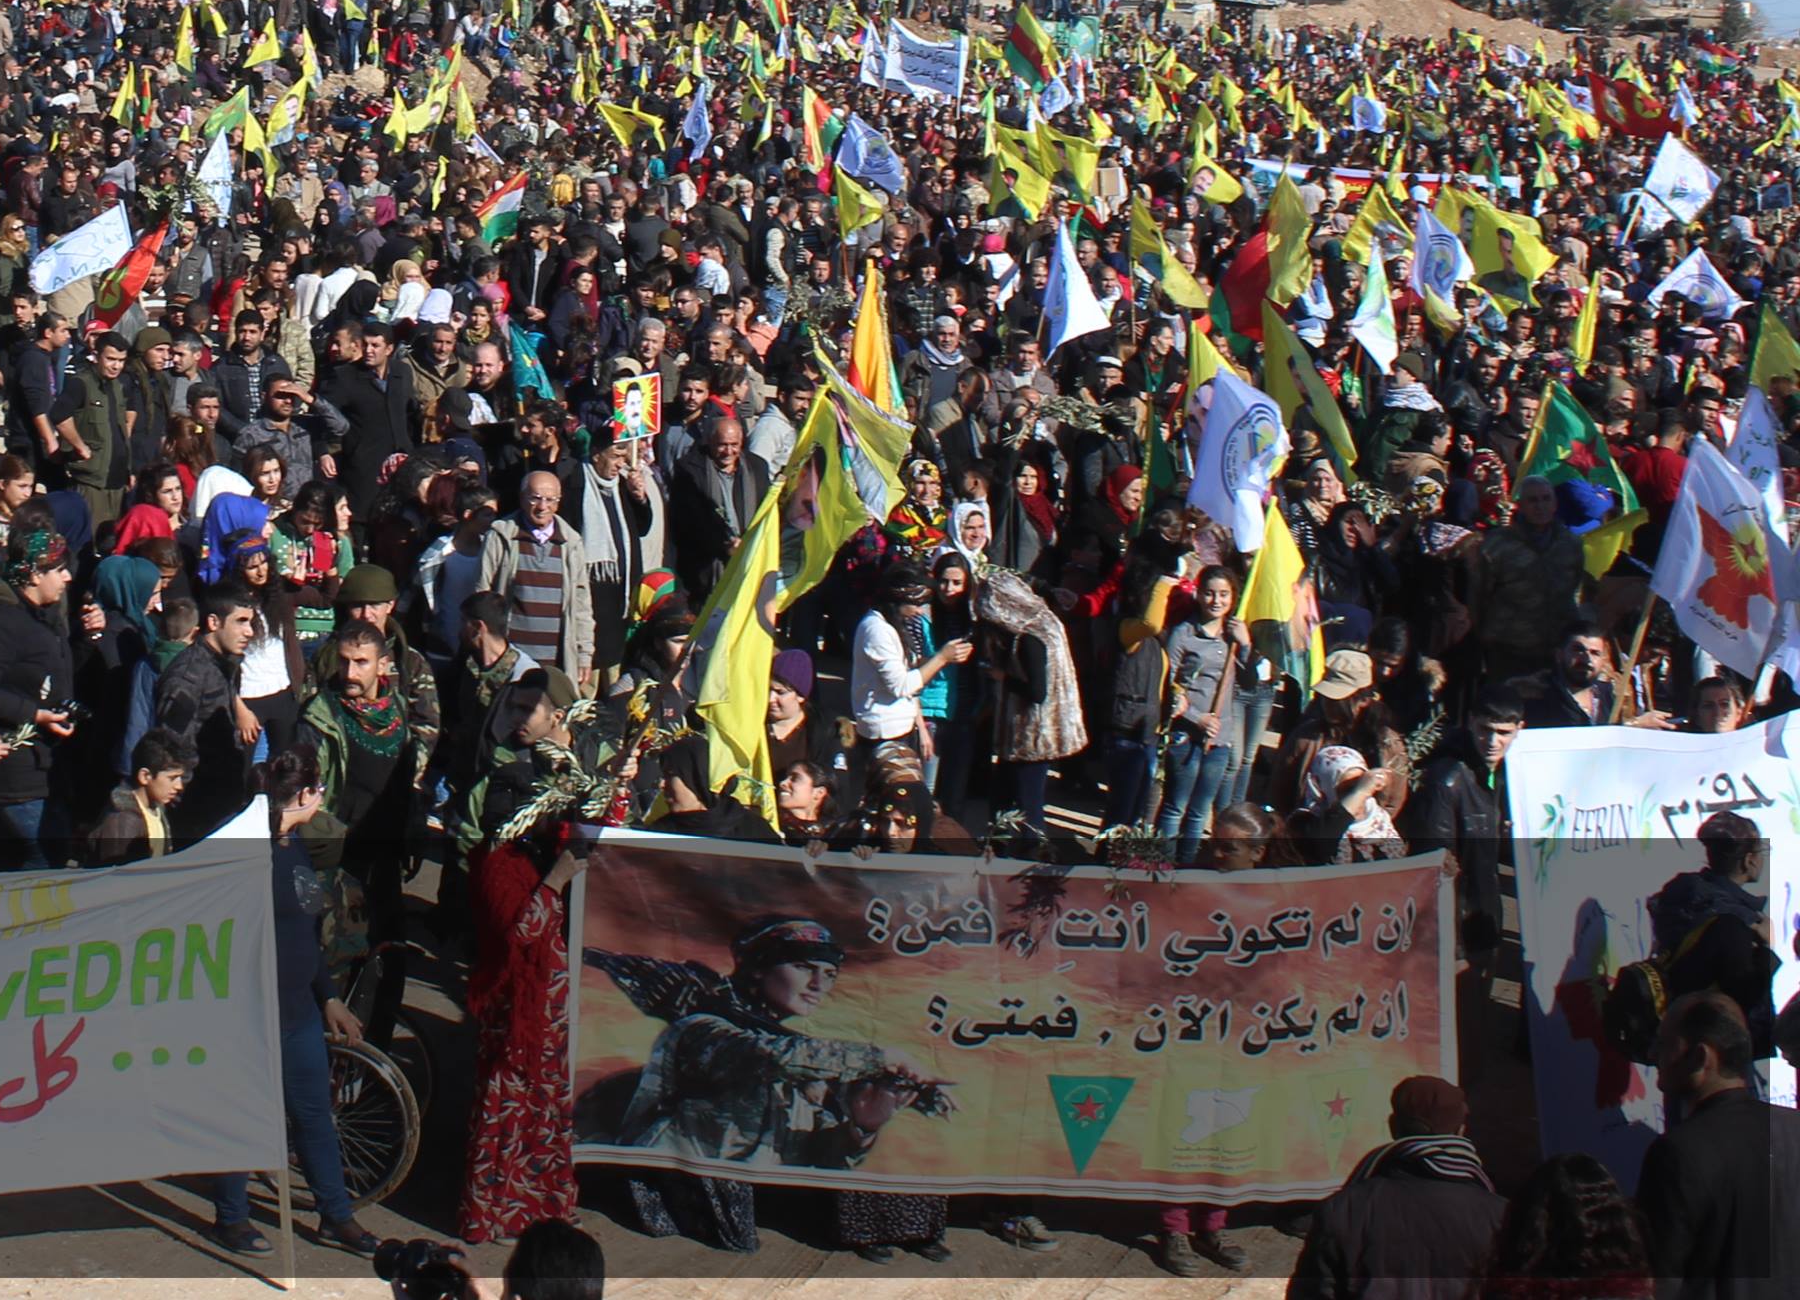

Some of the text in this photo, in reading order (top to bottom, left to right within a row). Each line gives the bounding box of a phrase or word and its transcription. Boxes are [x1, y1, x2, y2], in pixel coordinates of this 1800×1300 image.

[1161, 906, 1314, 976] تكوني
[1320, 902, 1363, 961] لم
[1374, 897, 1417, 953] إن
[1133, 994, 1232, 1053] الآن
[1240, 996, 1320, 1057] يكن
[1325, 991, 1367, 1047] لم
[1369, 980, 1410, 1040] إن
